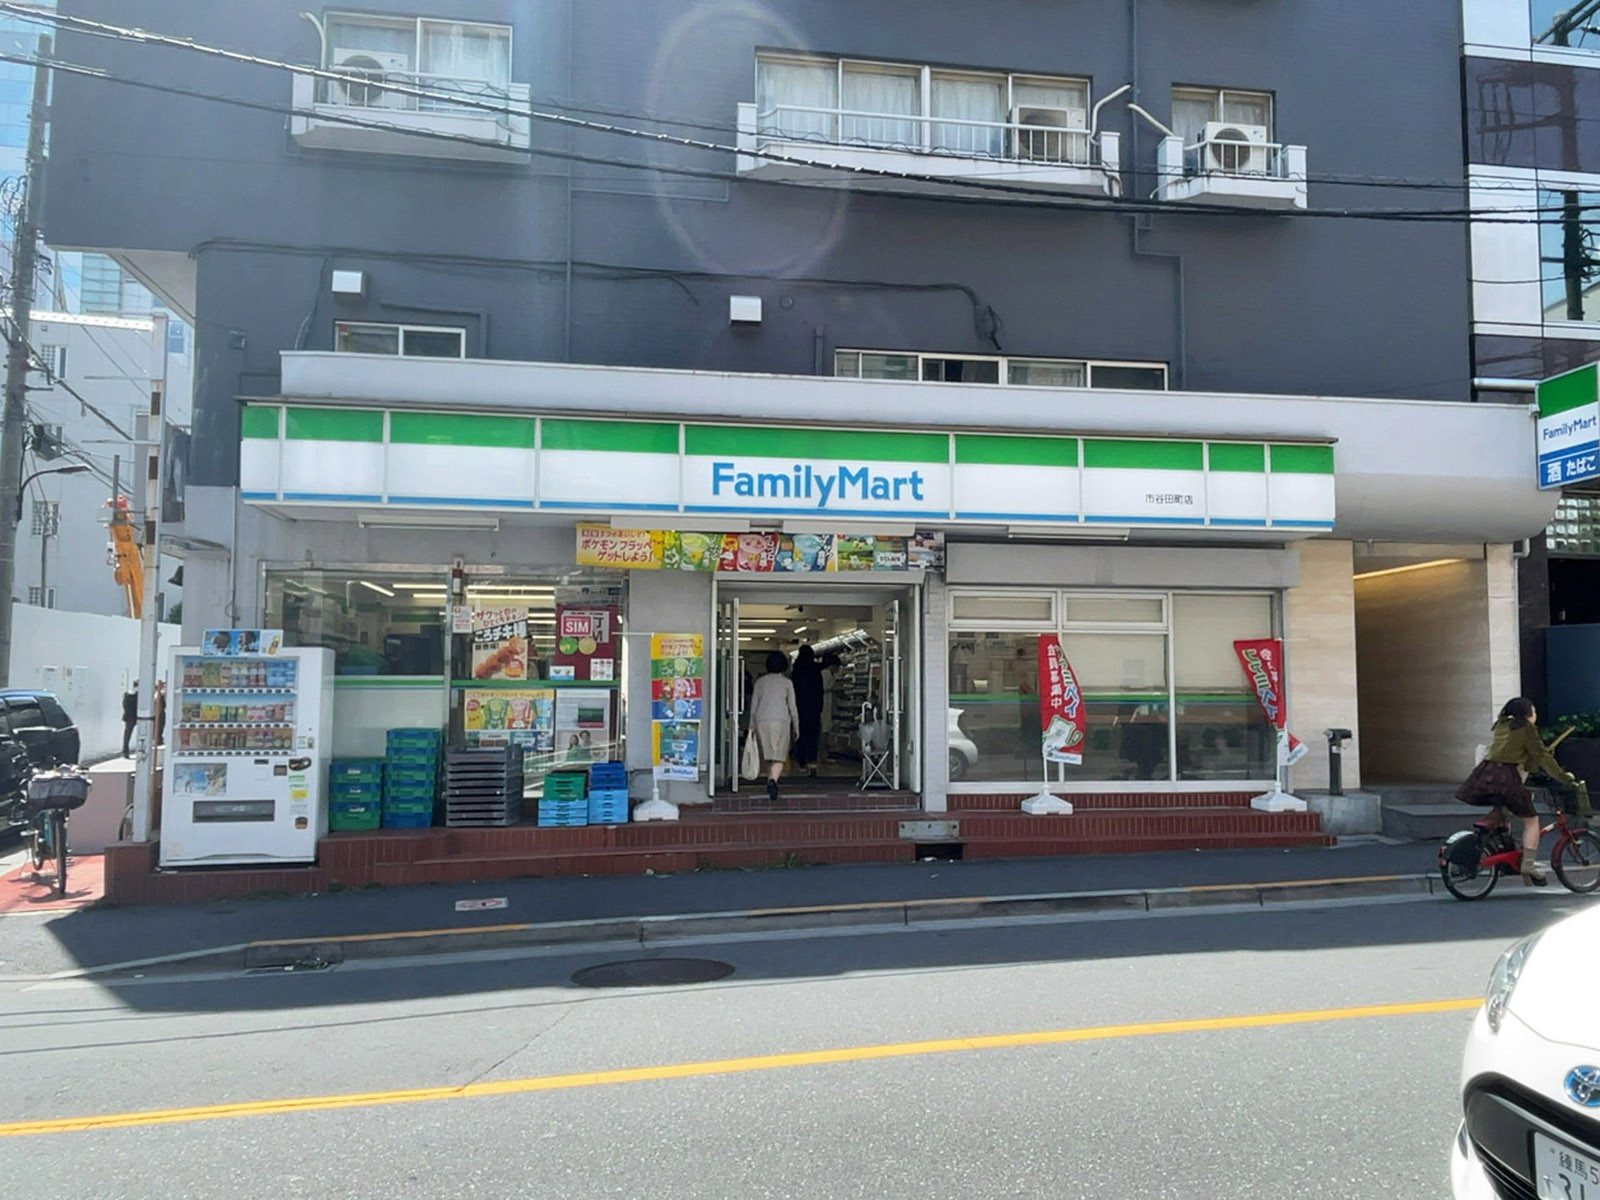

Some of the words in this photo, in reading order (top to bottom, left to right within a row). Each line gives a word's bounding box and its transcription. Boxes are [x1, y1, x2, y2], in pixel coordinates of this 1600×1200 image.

[1543, 416, 1597, 440] FamilyMart
[1547, 461, 1562, 483] 酒
[1566, 455, 1597, 476] たばこ
[712, 462, 924, 507] FamilyMart
[1145, 493, 1193, 505] 市谷田町店
[565, 622, 589, 633] SIM
